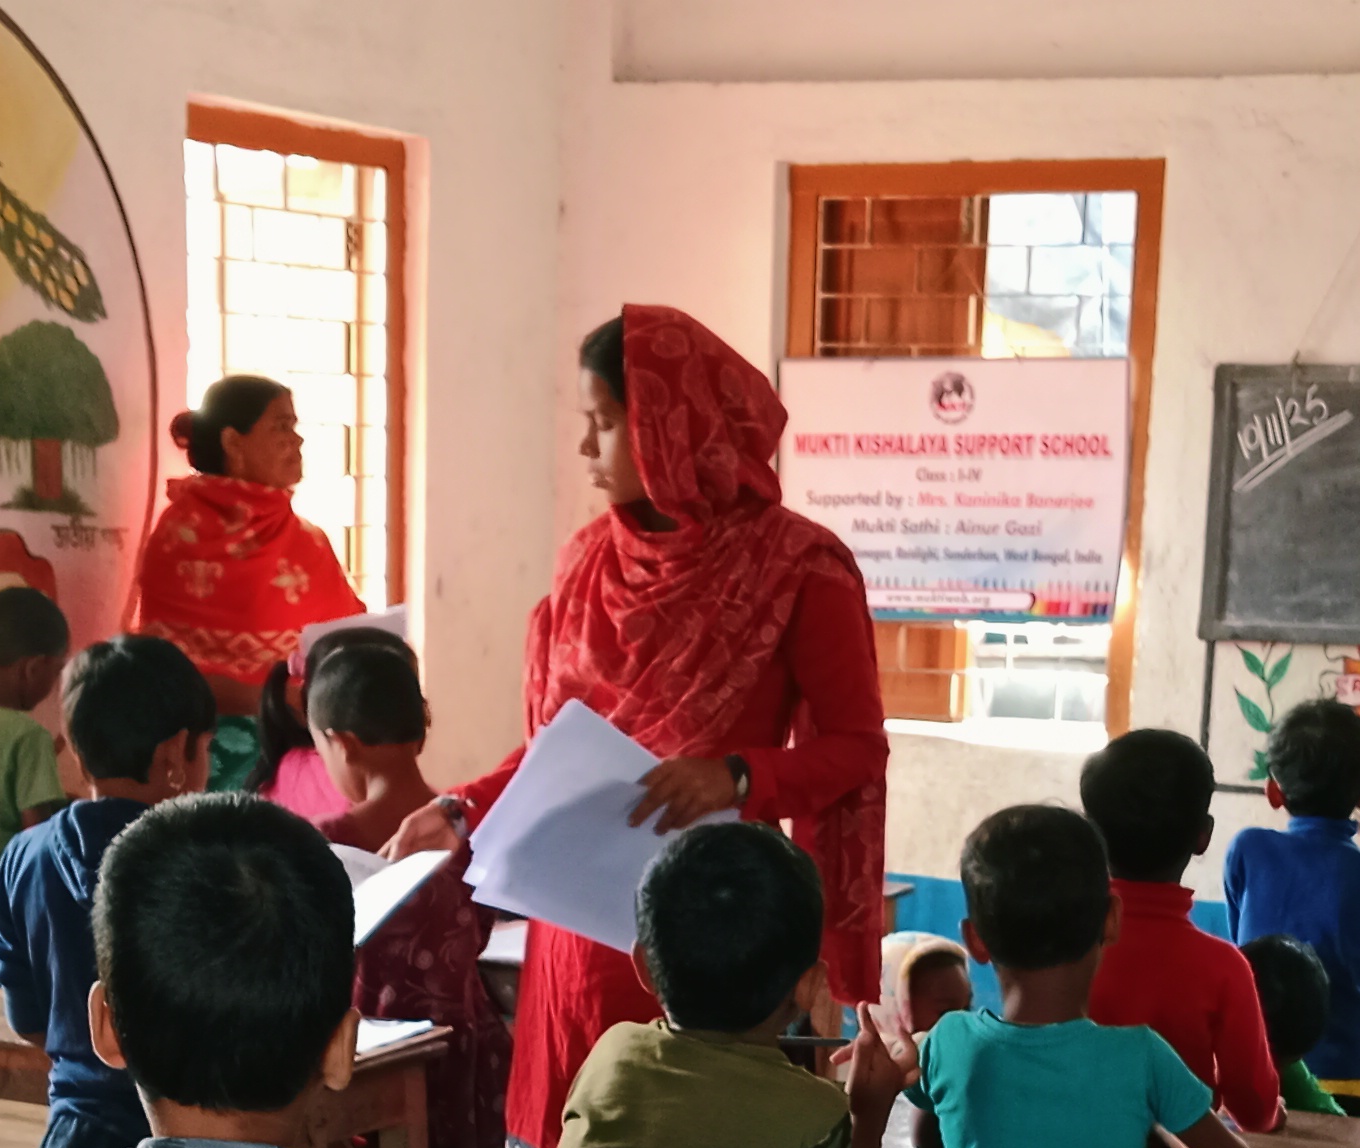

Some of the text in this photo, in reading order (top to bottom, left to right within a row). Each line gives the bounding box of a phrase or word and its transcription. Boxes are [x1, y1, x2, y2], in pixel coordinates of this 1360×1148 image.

[794, 434, 1112, 458] MUKTI KISHALAYA SUPPORT SCHOOL
[806, 490, 881, 508] Supported
[886, 491, 904, 509] by
[917, 491, 947, 508] Mrs.
[851, 517, 896, 534] Mukti
[900, 518, 940, 535] Sathi
[954, 519, 999, 536] Ainur
[1004, 519, 1042, 536] Gazi
[1074, 549, 1102, 564] India
